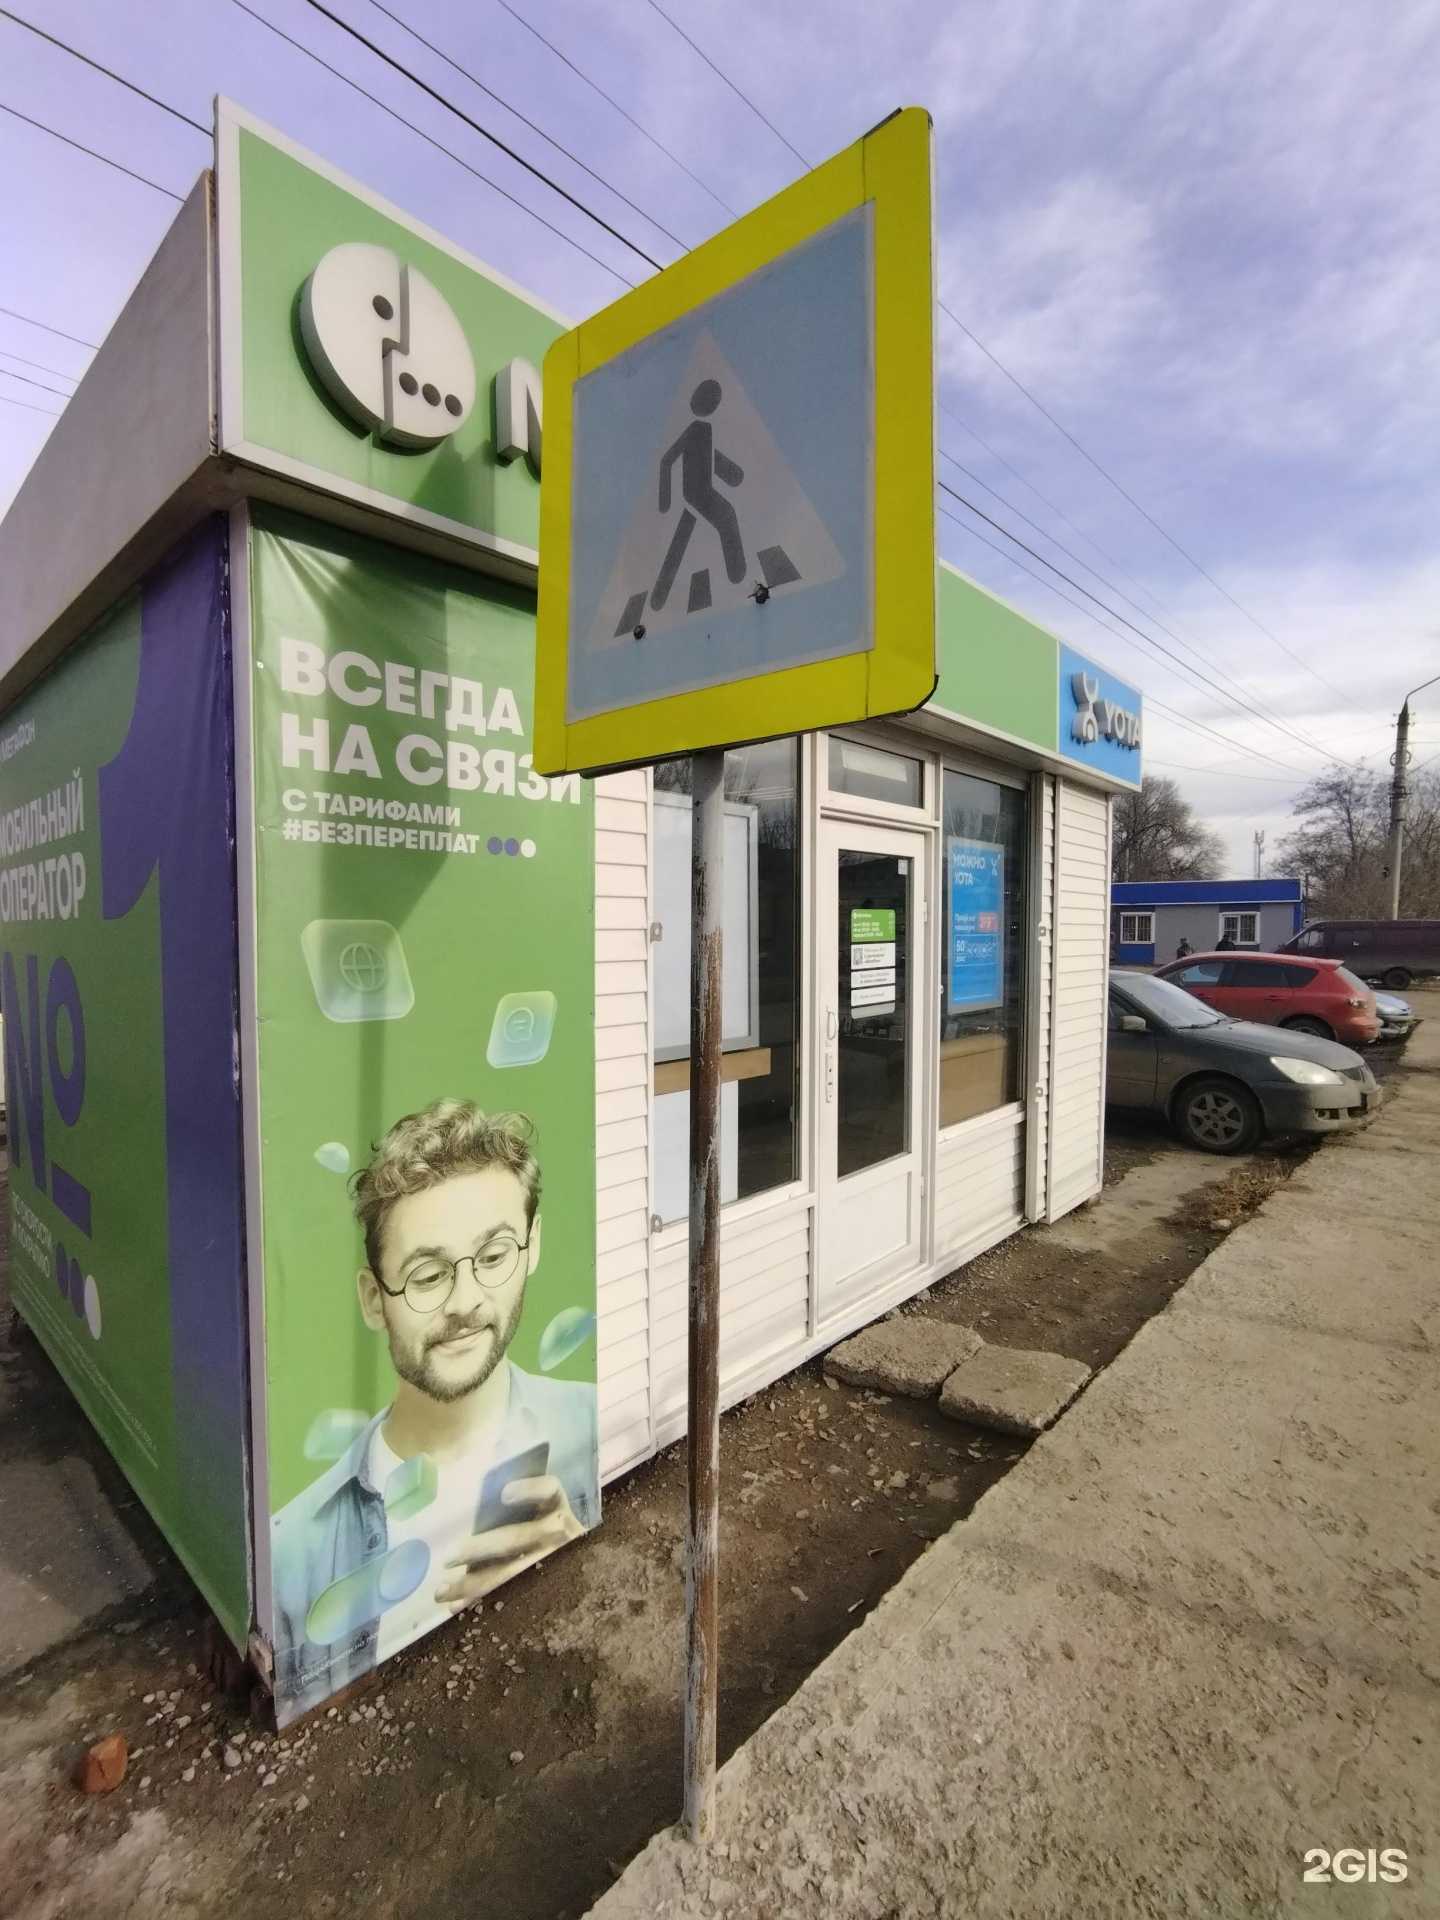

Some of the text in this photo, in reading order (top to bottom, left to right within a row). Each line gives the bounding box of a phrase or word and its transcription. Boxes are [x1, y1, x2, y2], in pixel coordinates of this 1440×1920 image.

[280, 638, 524, 737] ВСЕГДА
[281, 712, 383, 779] НА
[1104, 700, 1141, 747] YOTA
[282, 789, 461, 827] С ТАРИФАМИ
[283, 819, 480, 853] #БЕЗПЕРЕПЛАТ
[0, 851, 87, 922] ОПЕРАТОР
